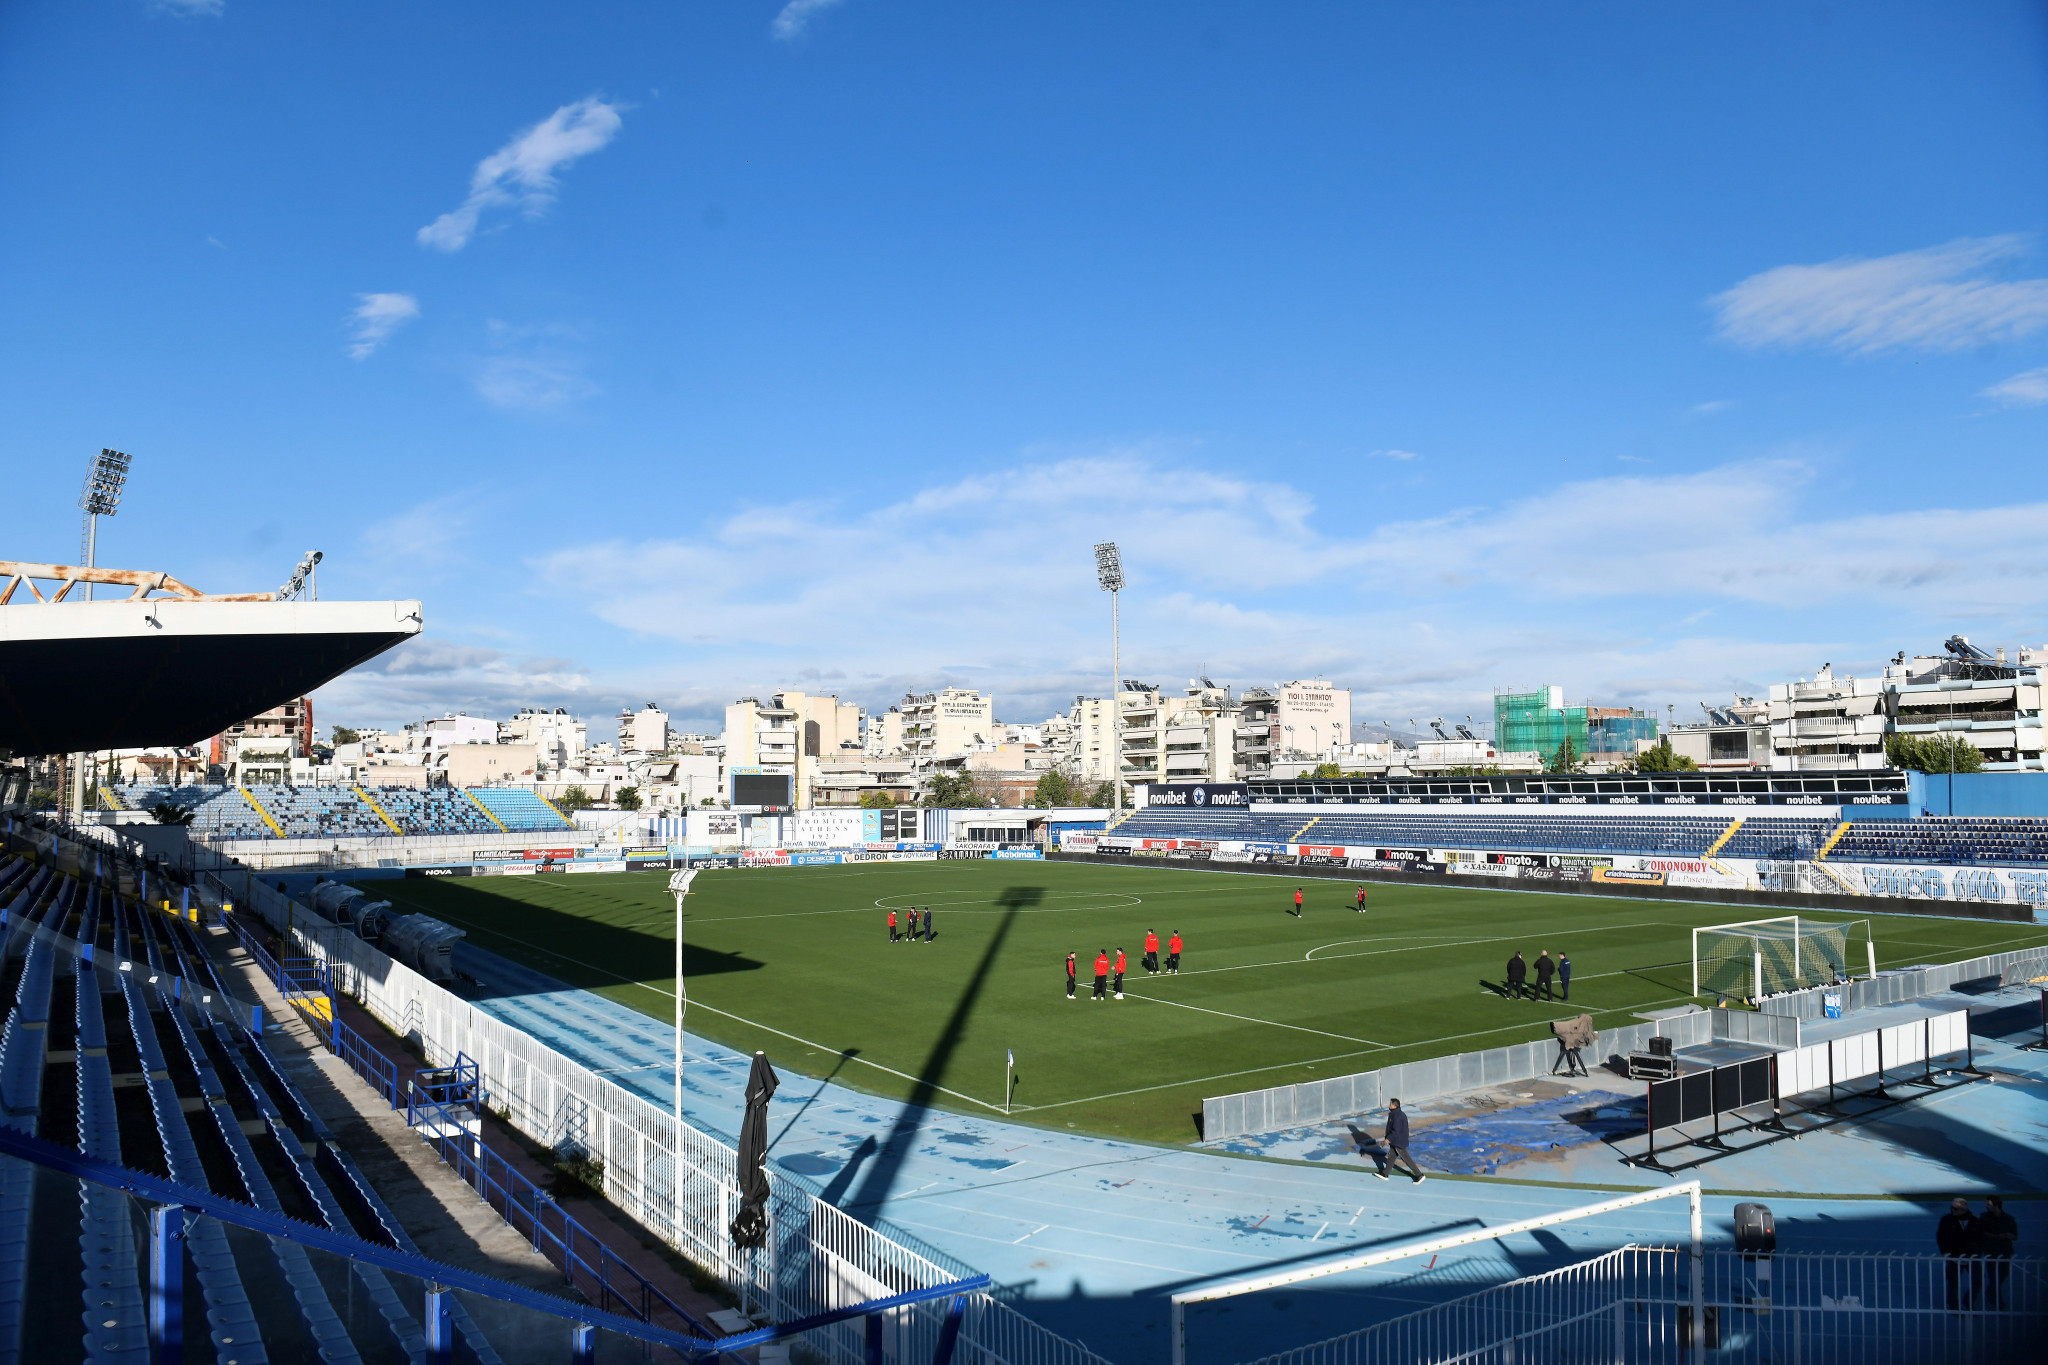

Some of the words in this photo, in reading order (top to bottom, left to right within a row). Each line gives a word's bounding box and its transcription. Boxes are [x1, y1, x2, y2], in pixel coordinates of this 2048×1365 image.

[1150, 791, 1187, 805] novibet
[1559, 796, 1587, 805] novibet
[1610, 796, 1640, 805] novibet
[1665, 796, 1696, 805] novibet
[1723, 796, 1757, 805] novibet
[1787, 796, 1823, 805] novibet
[1853, 796, 1892, 805] novibet
[694, 859, 729, 868] novibet
[1497, 855, 1539, 866] Xmoto.gr
